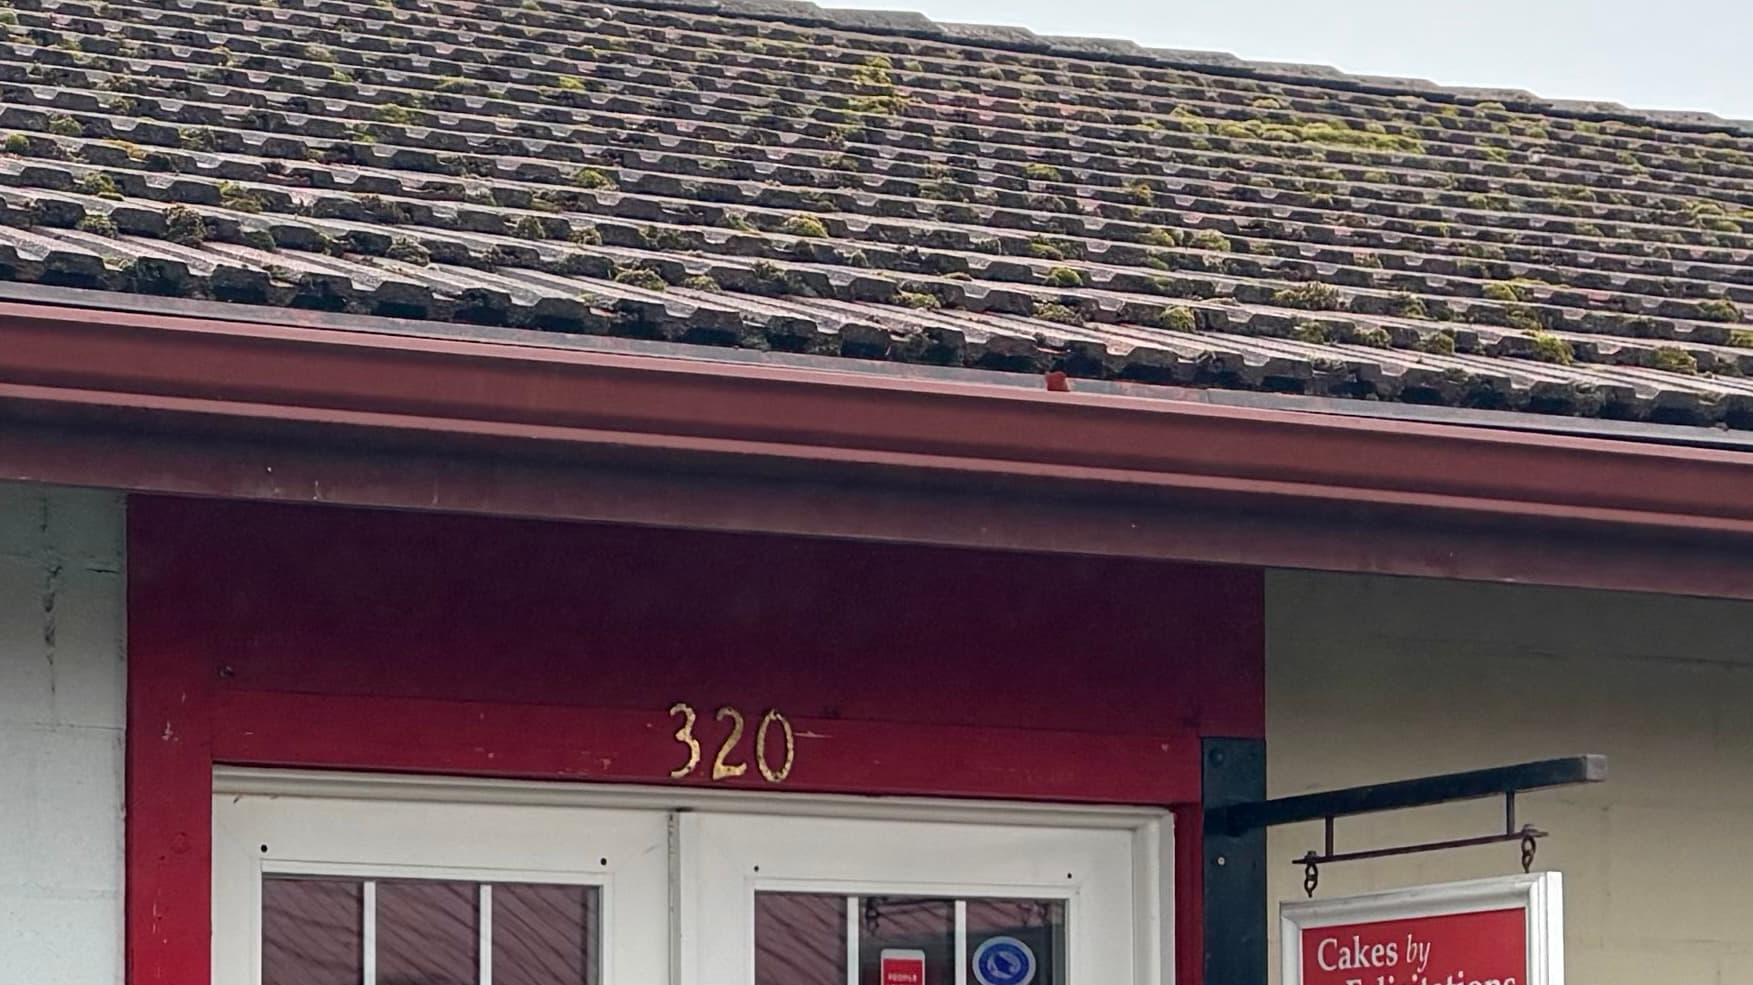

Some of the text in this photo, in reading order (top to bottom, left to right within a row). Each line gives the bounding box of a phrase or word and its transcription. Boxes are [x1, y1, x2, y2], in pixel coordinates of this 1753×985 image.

[670, 703, 794, 783] 320
[1317, 934, 1431, 973] Cakes by
